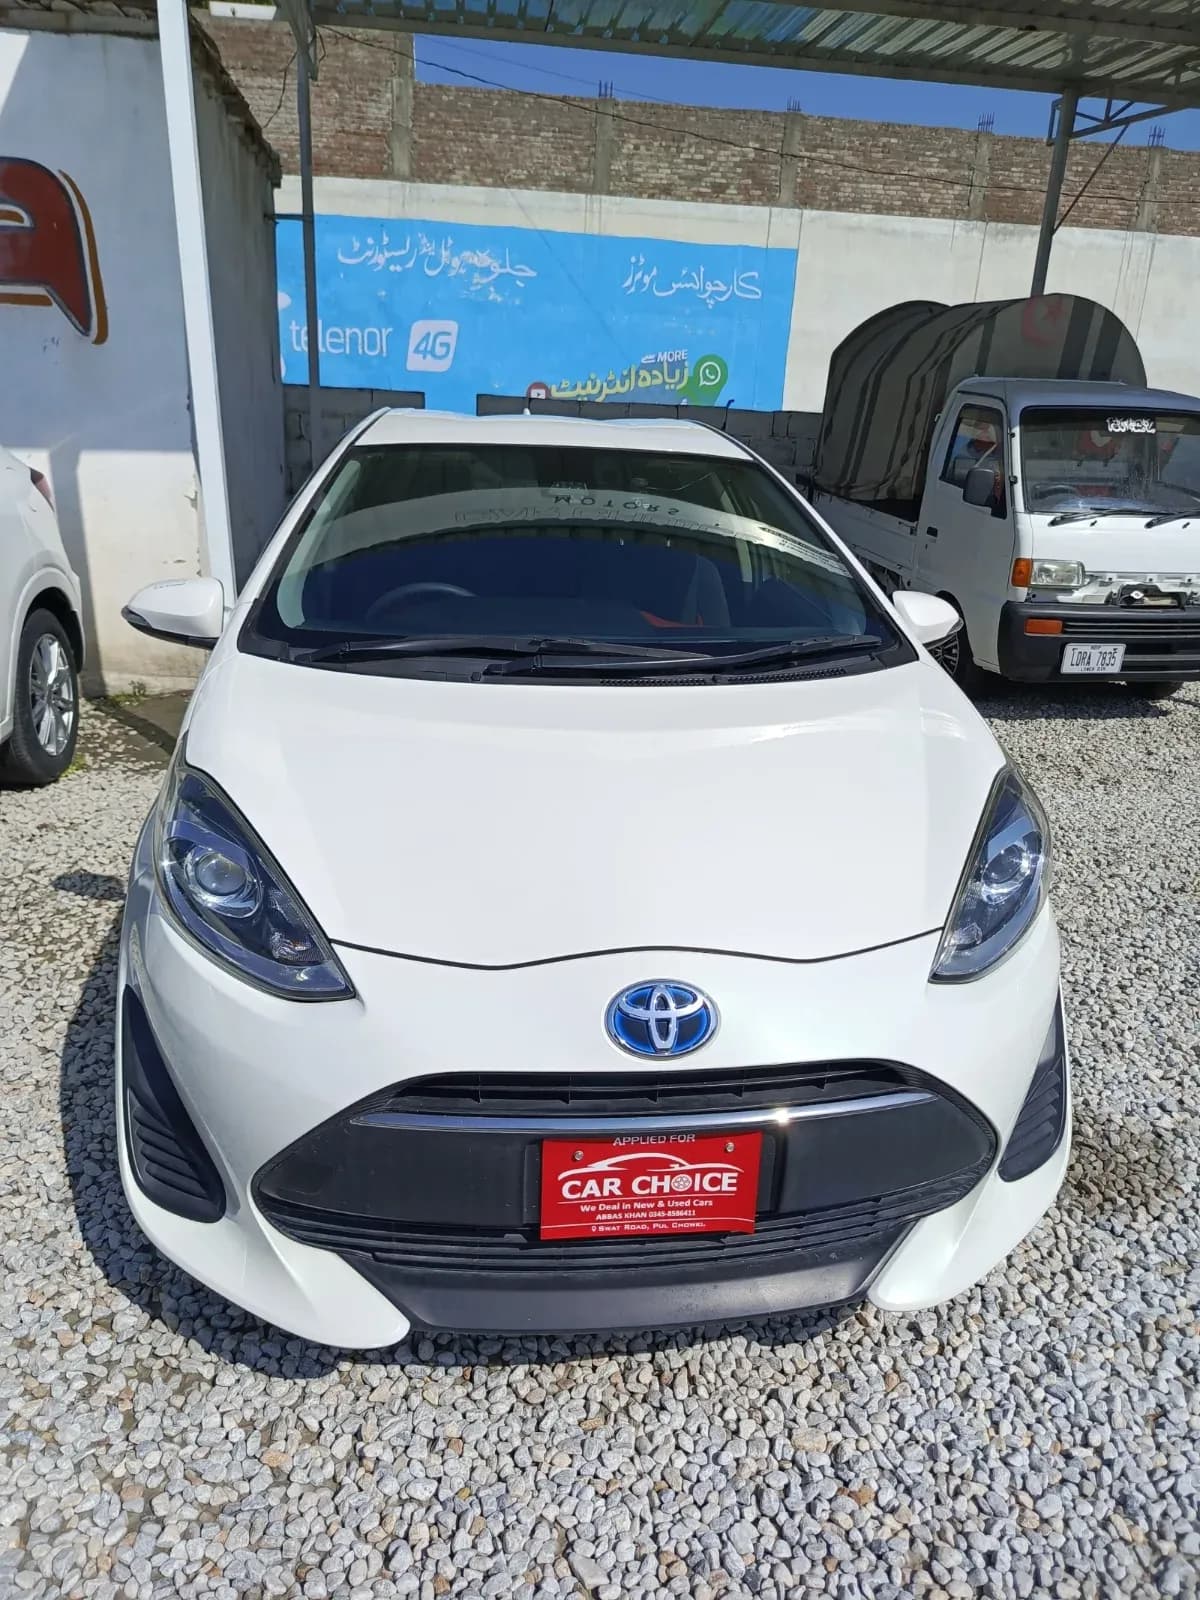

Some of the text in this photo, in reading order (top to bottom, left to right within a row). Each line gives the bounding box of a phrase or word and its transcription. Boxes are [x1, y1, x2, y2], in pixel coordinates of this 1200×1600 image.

[714, 268, 762, 301] کار
[413, 331, 451, 360] 4G
[657, 349, 688, 362] MORE
[551, 361, 688, 402] زیادہ انٹرنیٹ
[1096, 649, 1118, 666] 7835
[613, 1133, 696, 1146] APPLIED FOR
[562, 1172, 738, 1199] CAR CHOICE
[580, 1198, 713, 1212] We Deal in New & Used Cars
[595, 1212, 623, 1221] ABBAS
[624, 1211, 647, 1219] KHAN
